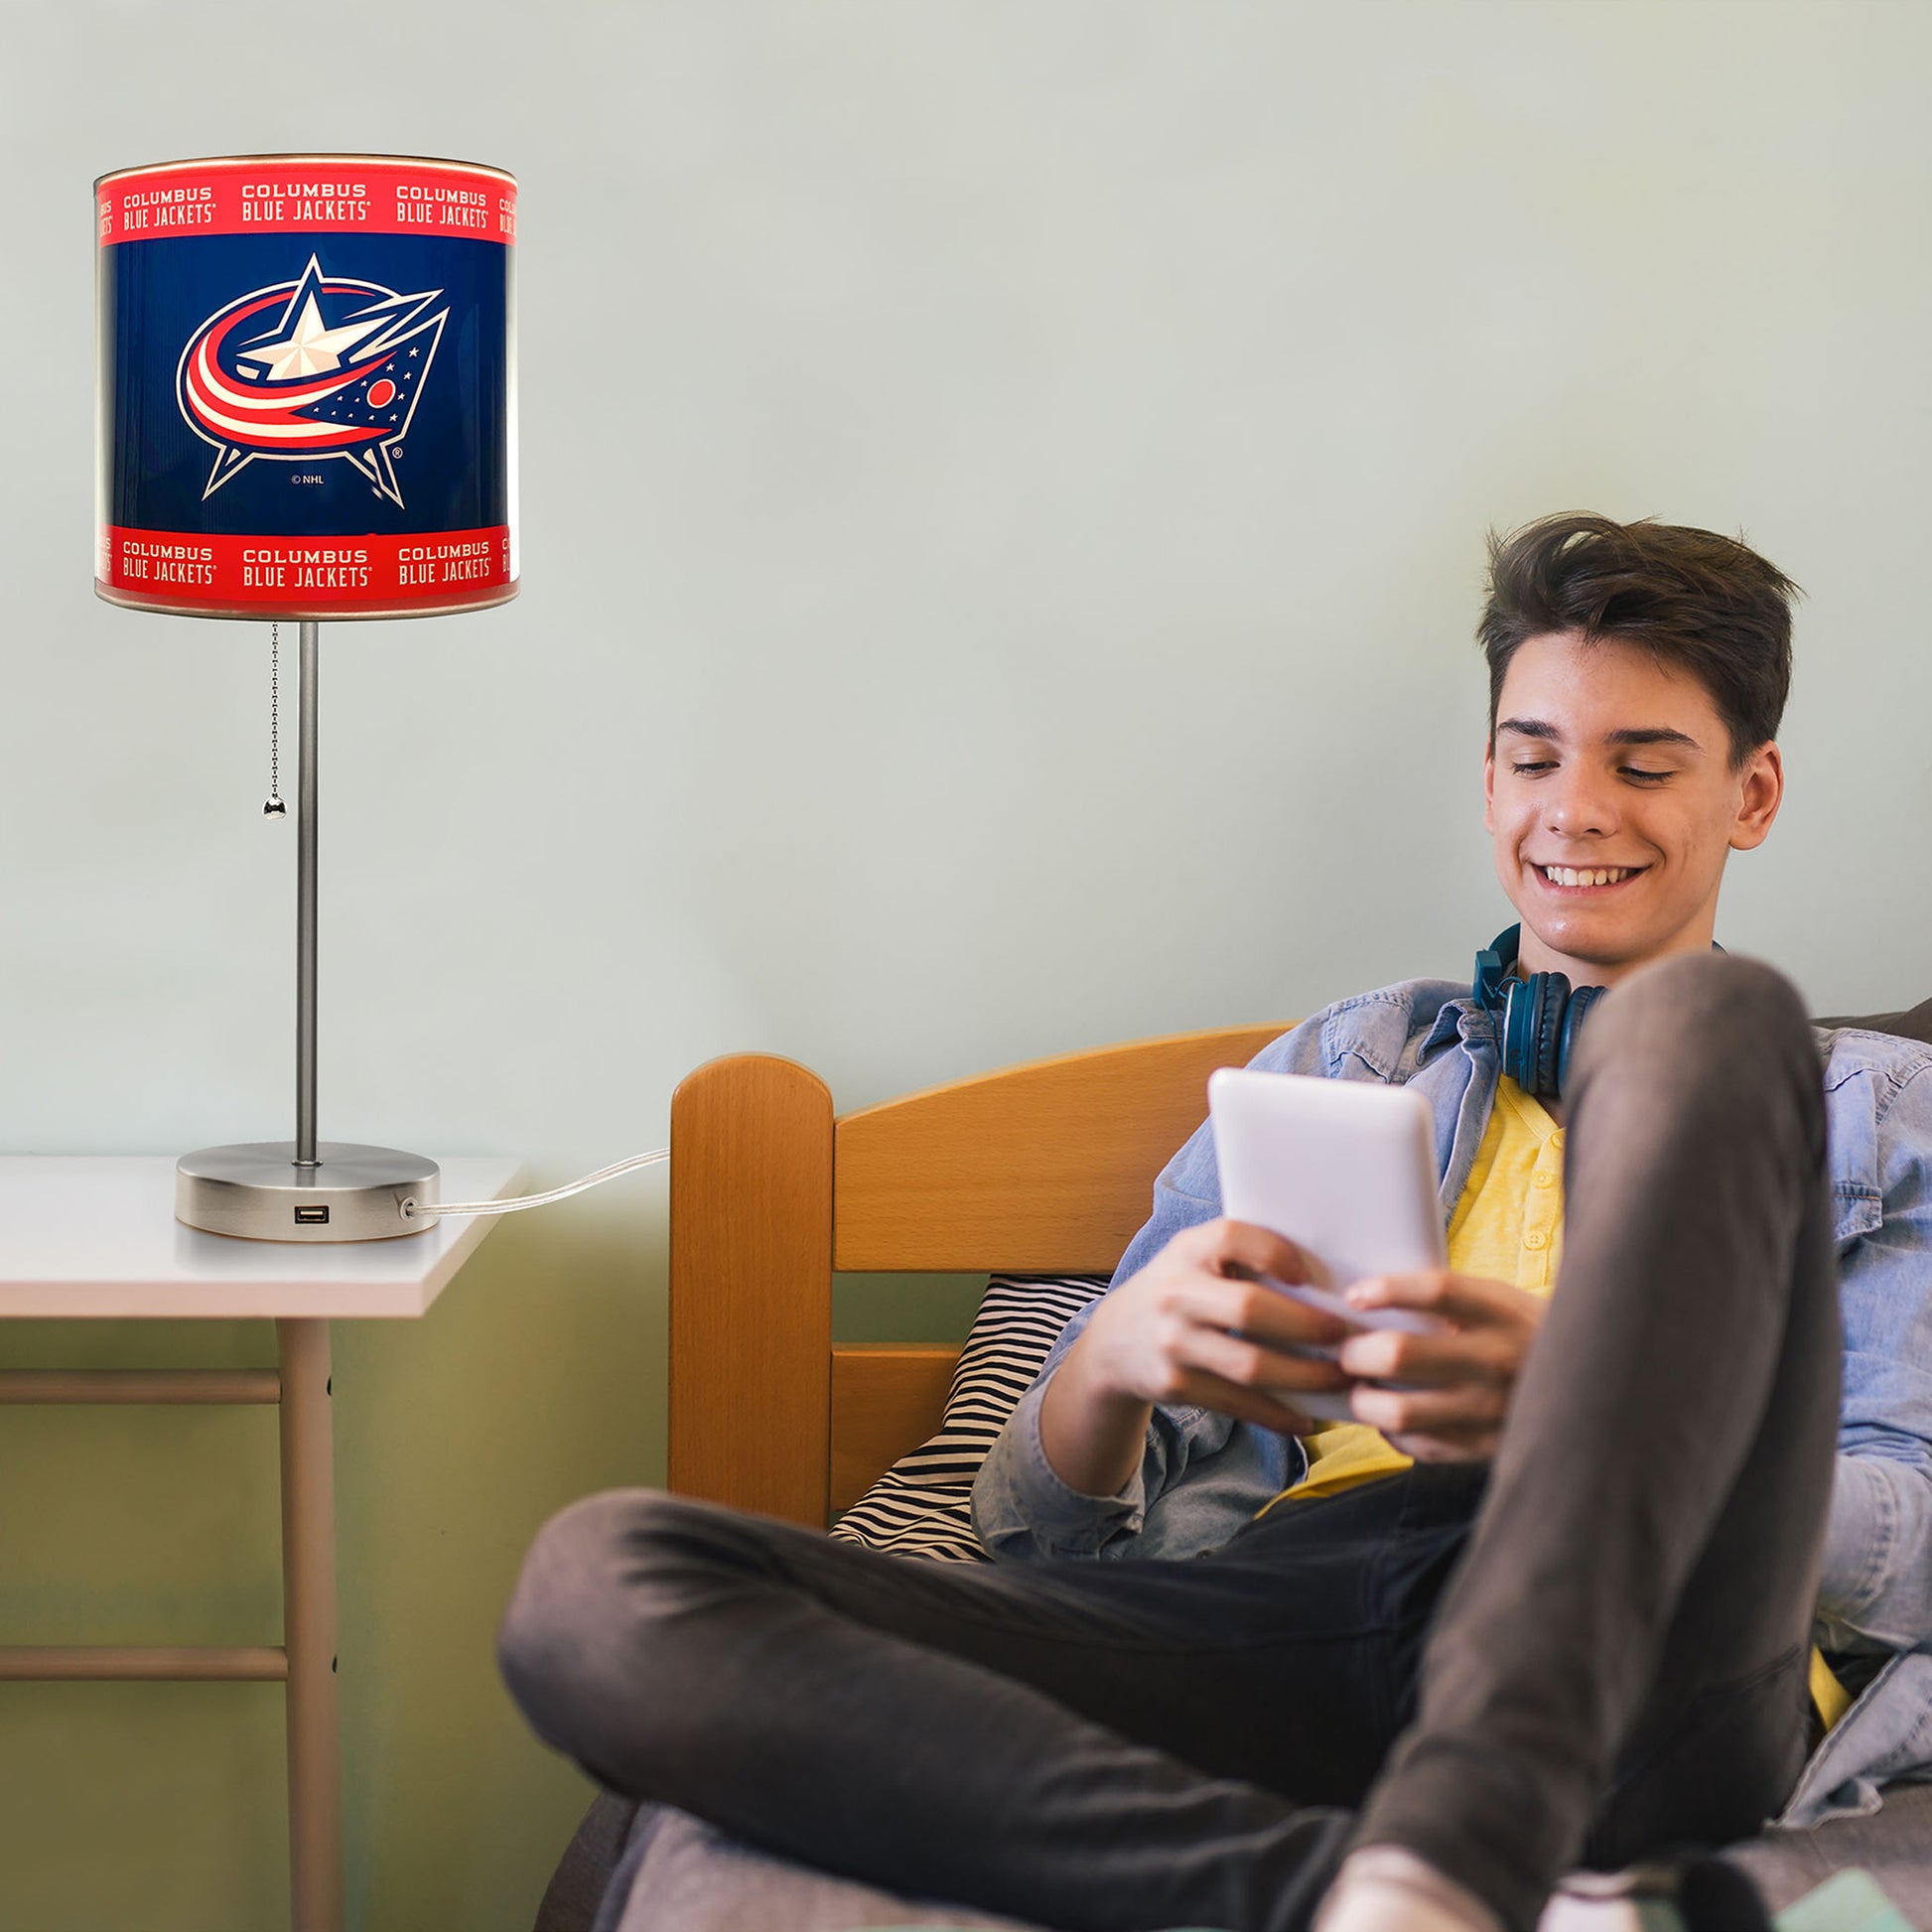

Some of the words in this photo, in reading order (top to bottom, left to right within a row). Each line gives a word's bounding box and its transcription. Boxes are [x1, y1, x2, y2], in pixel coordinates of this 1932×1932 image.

[123, 187, 212, 209] COLUMBUS
[241, 184, 366, 199] COLUMBUS
[396, 186, 486, 207] COLUMBUS
[123, 207, 150, 231] BLUE
[153, 203, 212, 228] JACKETS
[242, 200, 285, 221] BLUE
[292, 200, 366, 221] JACKETS
[396, 202, 433, 224] BLUE
[438, 205, 486, 229] JACKETS
[123, 541, 212, 561] COLUMBUS
[243, 549, 367, 564] COLUMBUS
[398, 541, 489, 562] COLUMBUS
[123, 557, 149, 579] BLUE
[153, 561, 212, 585] JACKETS
[243, 566, 285, 588] BLUE
[294, 566, 368, 588] JACKETS
[398, 562, 437, 585] BLUE
[441, 557, 489, 582] JACKETS
